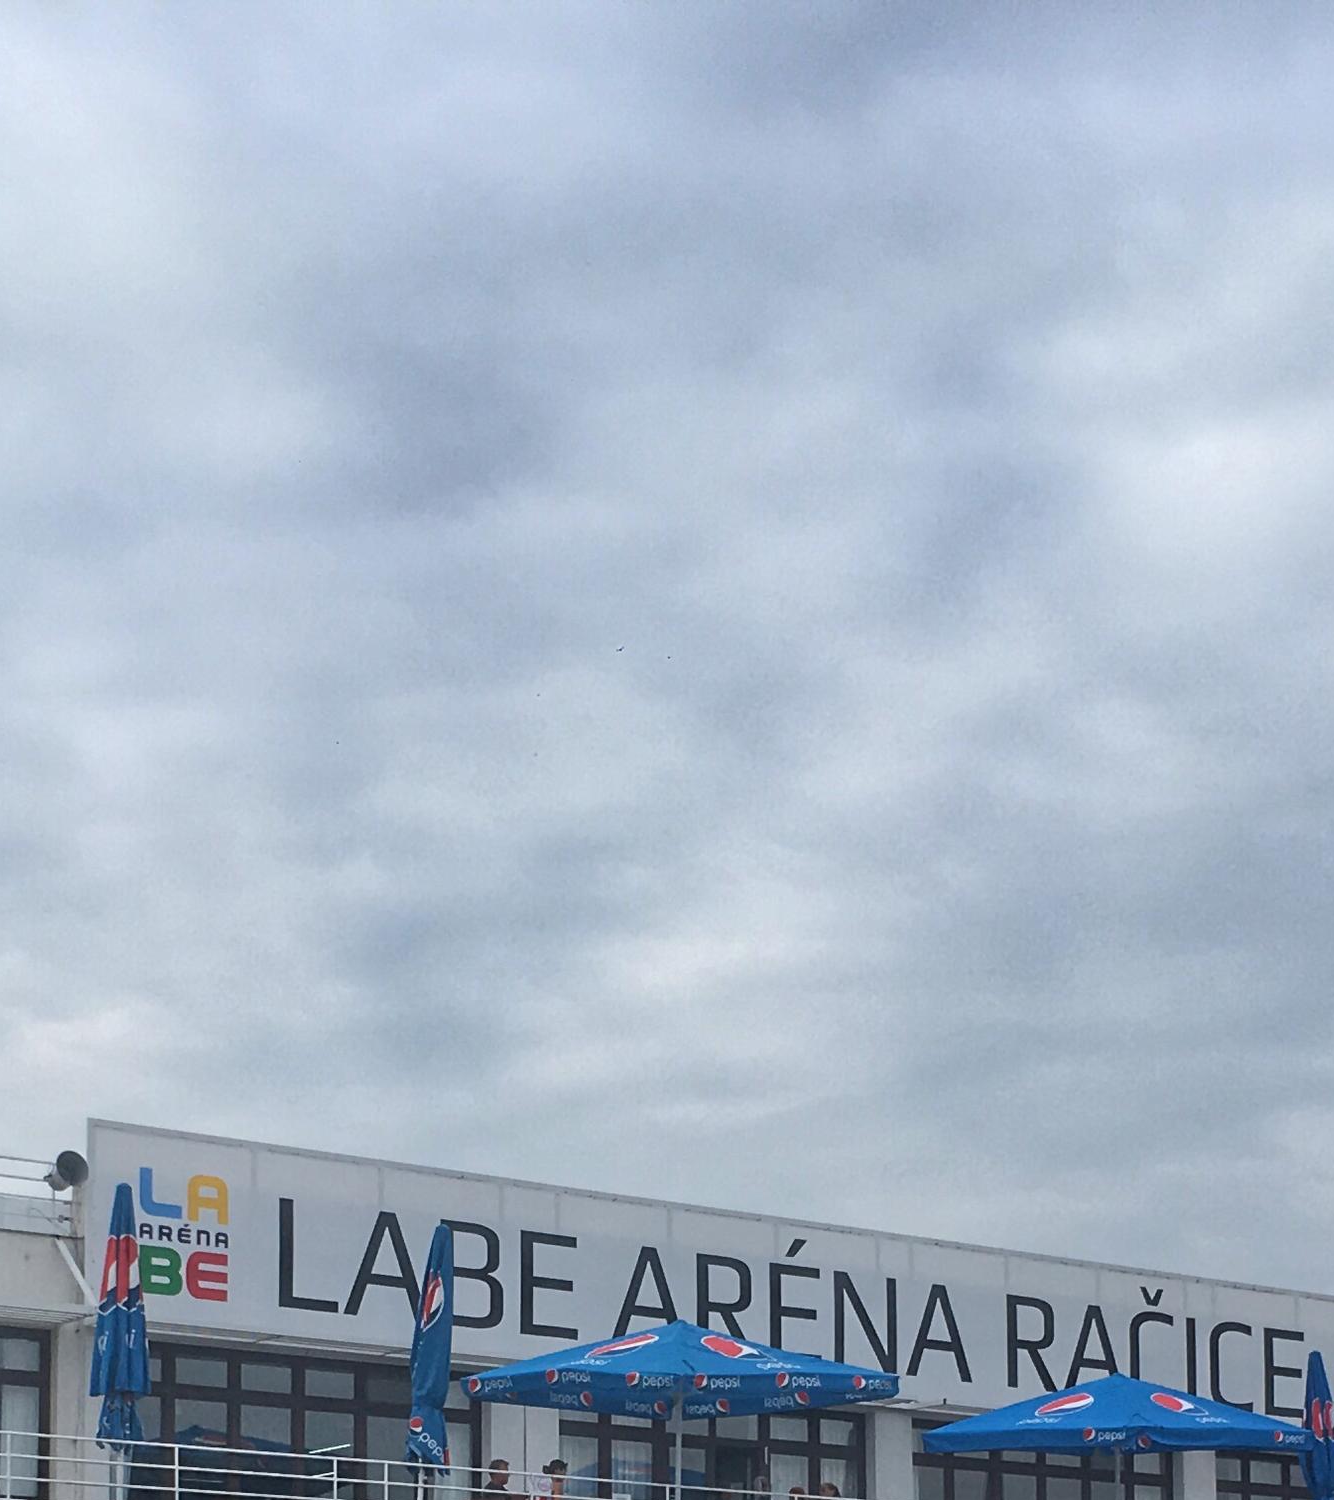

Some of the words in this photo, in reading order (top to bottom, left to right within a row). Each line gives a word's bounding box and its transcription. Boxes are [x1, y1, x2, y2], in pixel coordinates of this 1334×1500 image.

[139, 1223, 229, 1249] ARÉNA
[278, 1197, 579, 1341] LABE
[612, 1238, 973, 1385] ARÉNA
[1006, 1286, 1305, 1418] RAČICE
[710, 1376, 741, 1390] pepsi
[791, 1375, 822, 1389] pepsi
